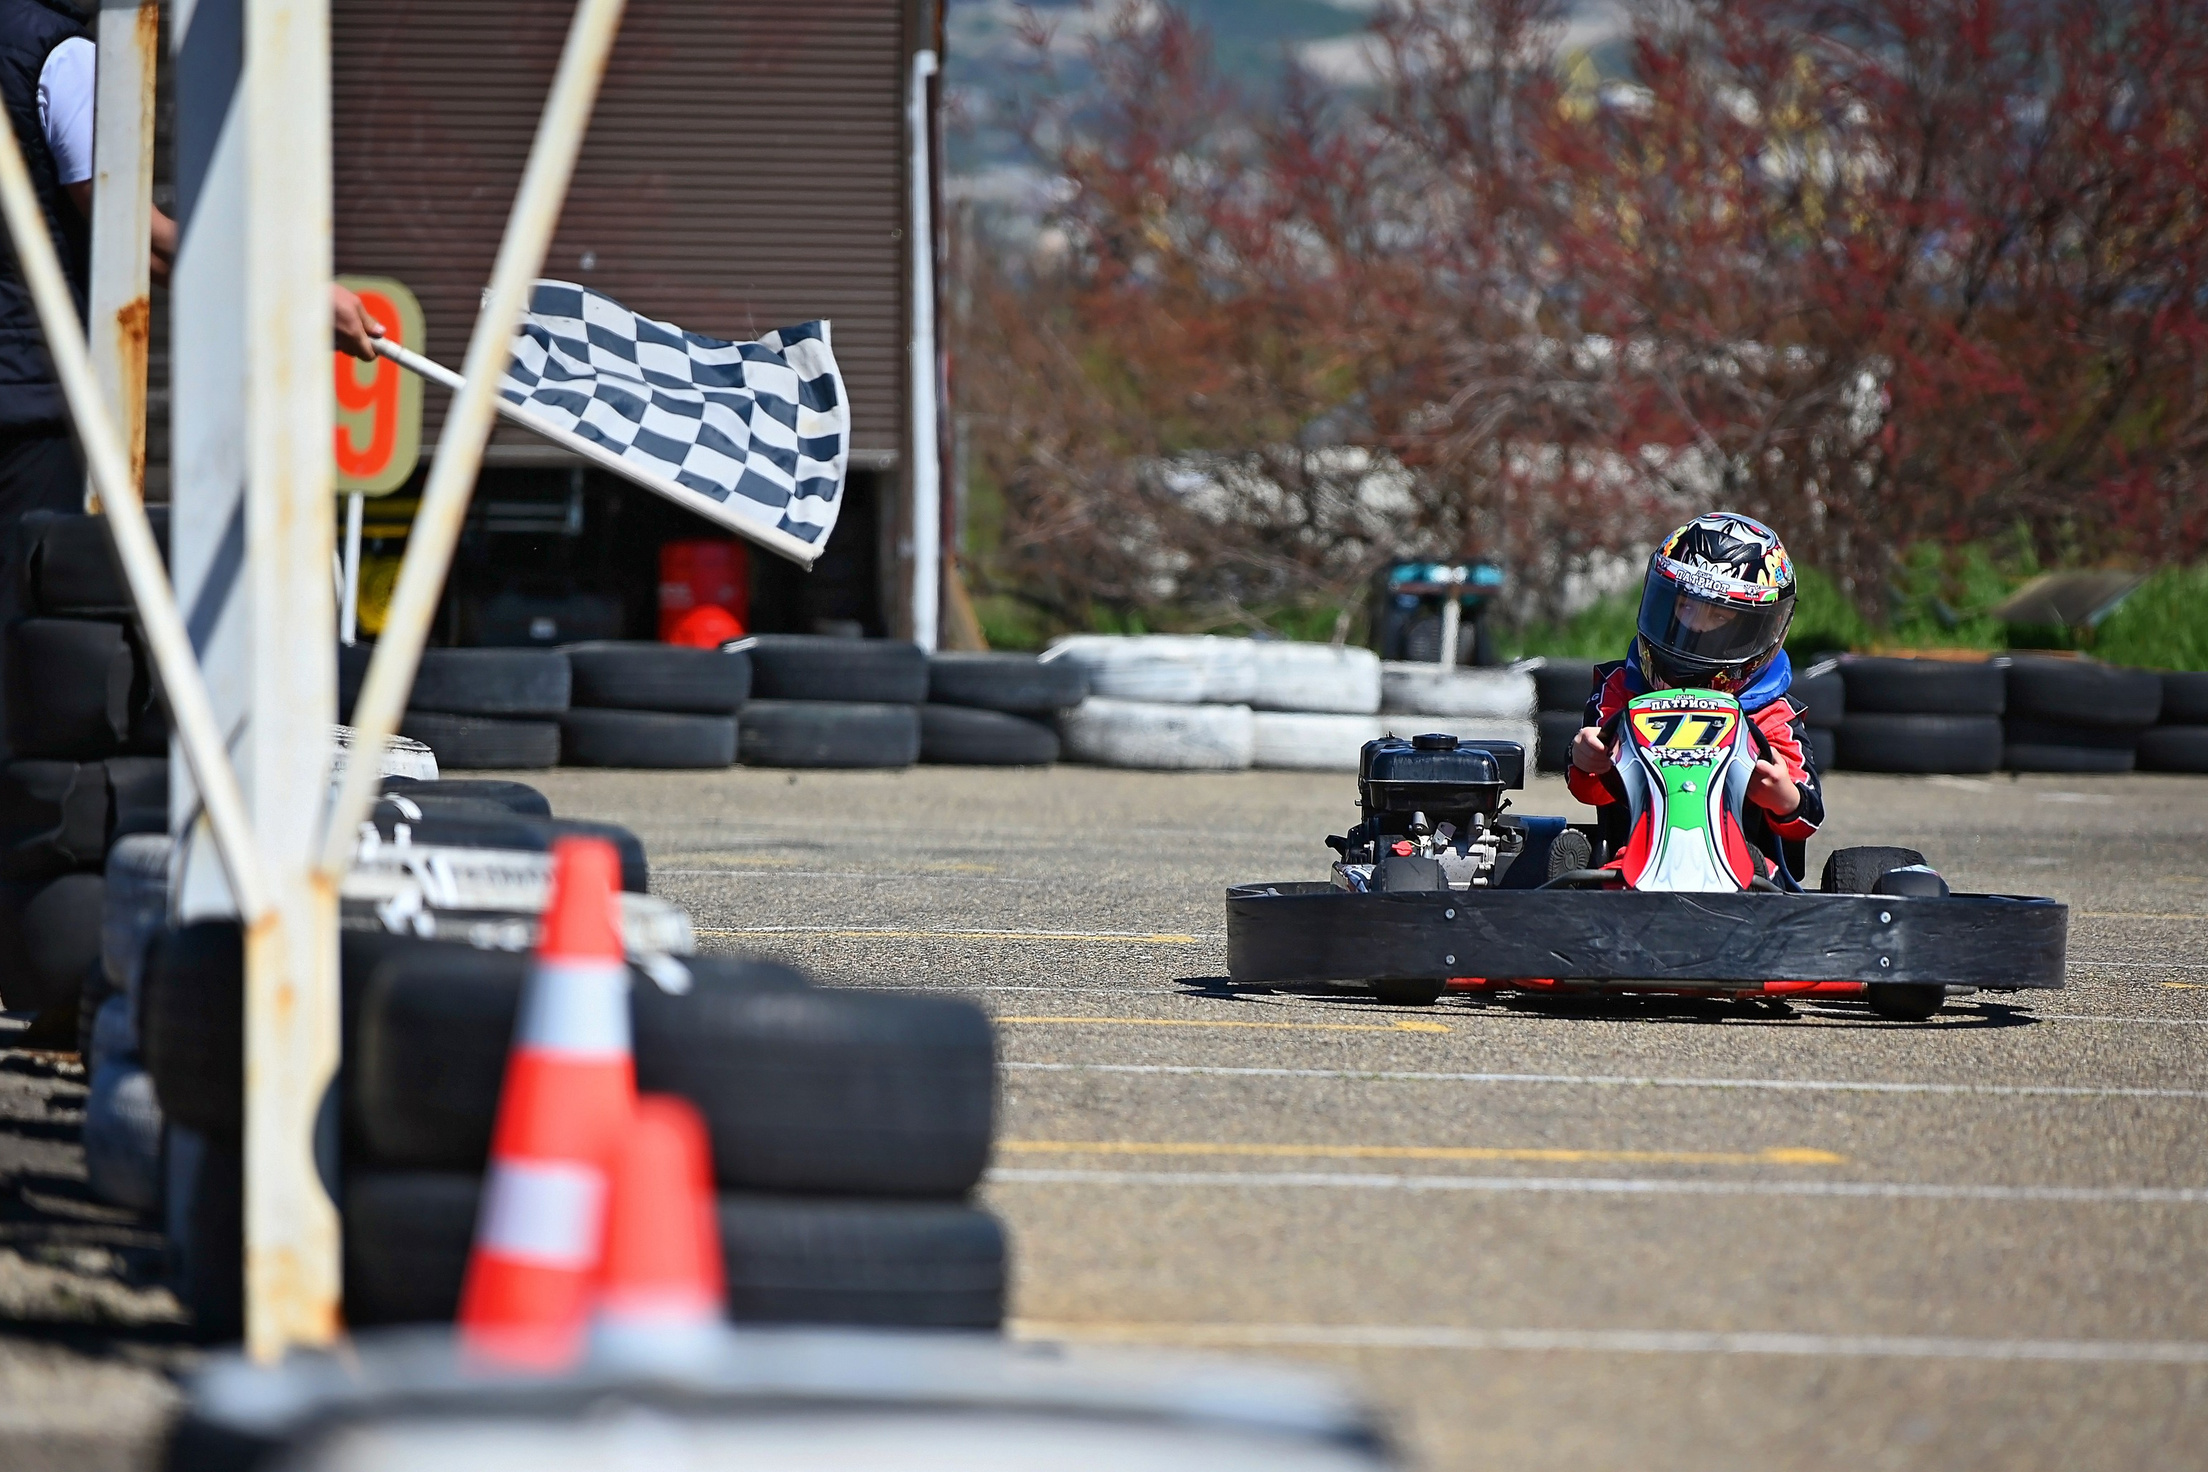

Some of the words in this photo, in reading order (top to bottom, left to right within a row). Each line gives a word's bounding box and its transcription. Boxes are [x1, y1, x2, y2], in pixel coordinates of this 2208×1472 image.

[334, 290, 402, 479] 9
[1676, 570, 1730, 593] ПАТРИОТ
[1646, 714, 1727, 747] 77
